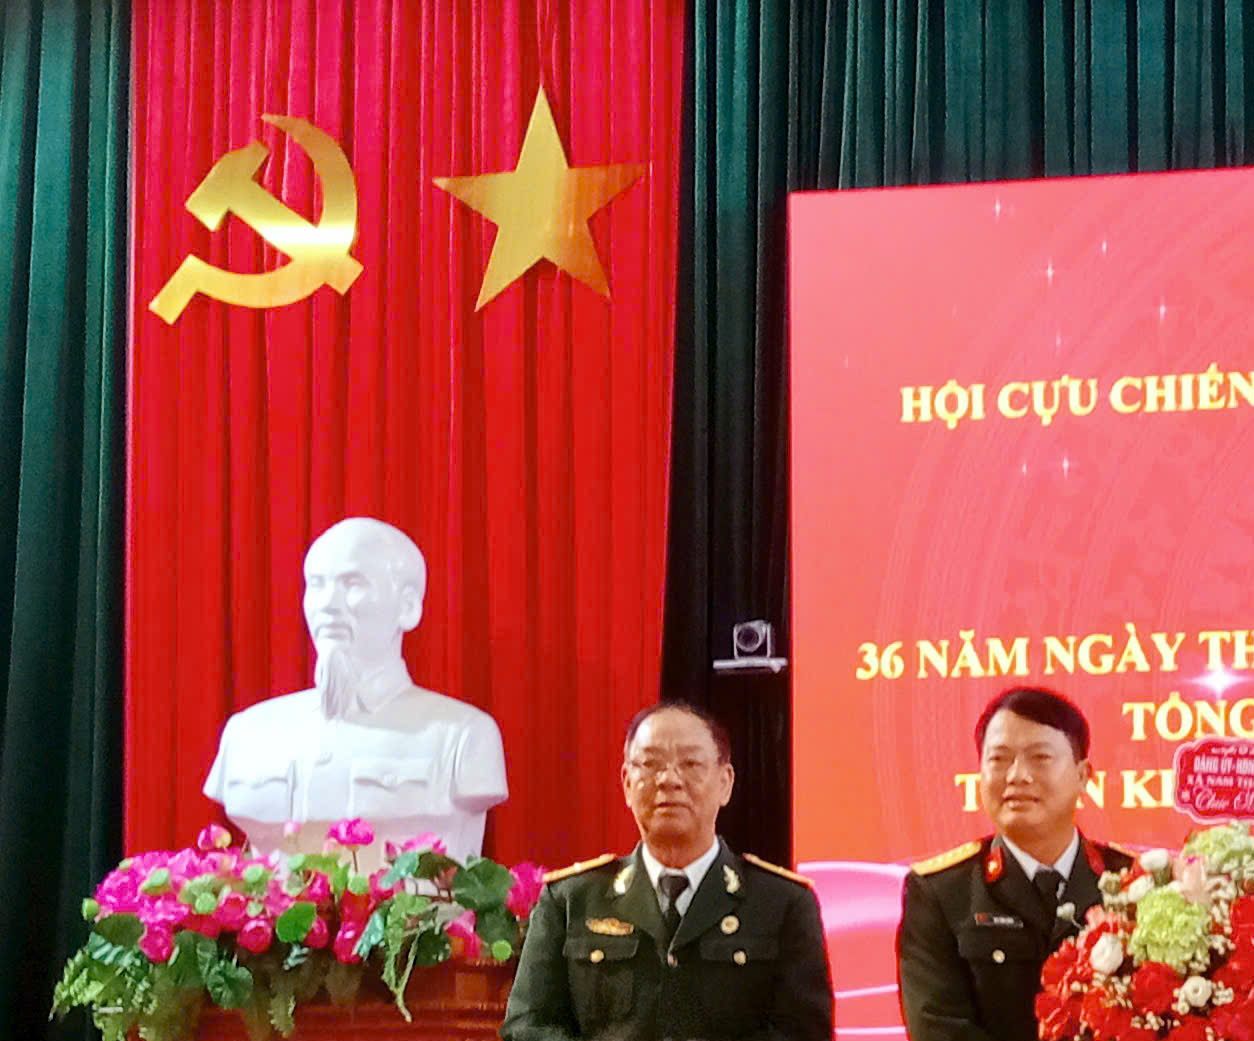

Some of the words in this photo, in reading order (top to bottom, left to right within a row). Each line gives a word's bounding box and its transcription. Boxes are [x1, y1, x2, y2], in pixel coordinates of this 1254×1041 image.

[900, 380, 985, 429] HỘI
[997, 375, 1098, 426] CỰU
[856, 641, 904, 680] 36
[916, 629, 1030, 679] NĂM
[1043, 622, 1186, 675] NGÀY
